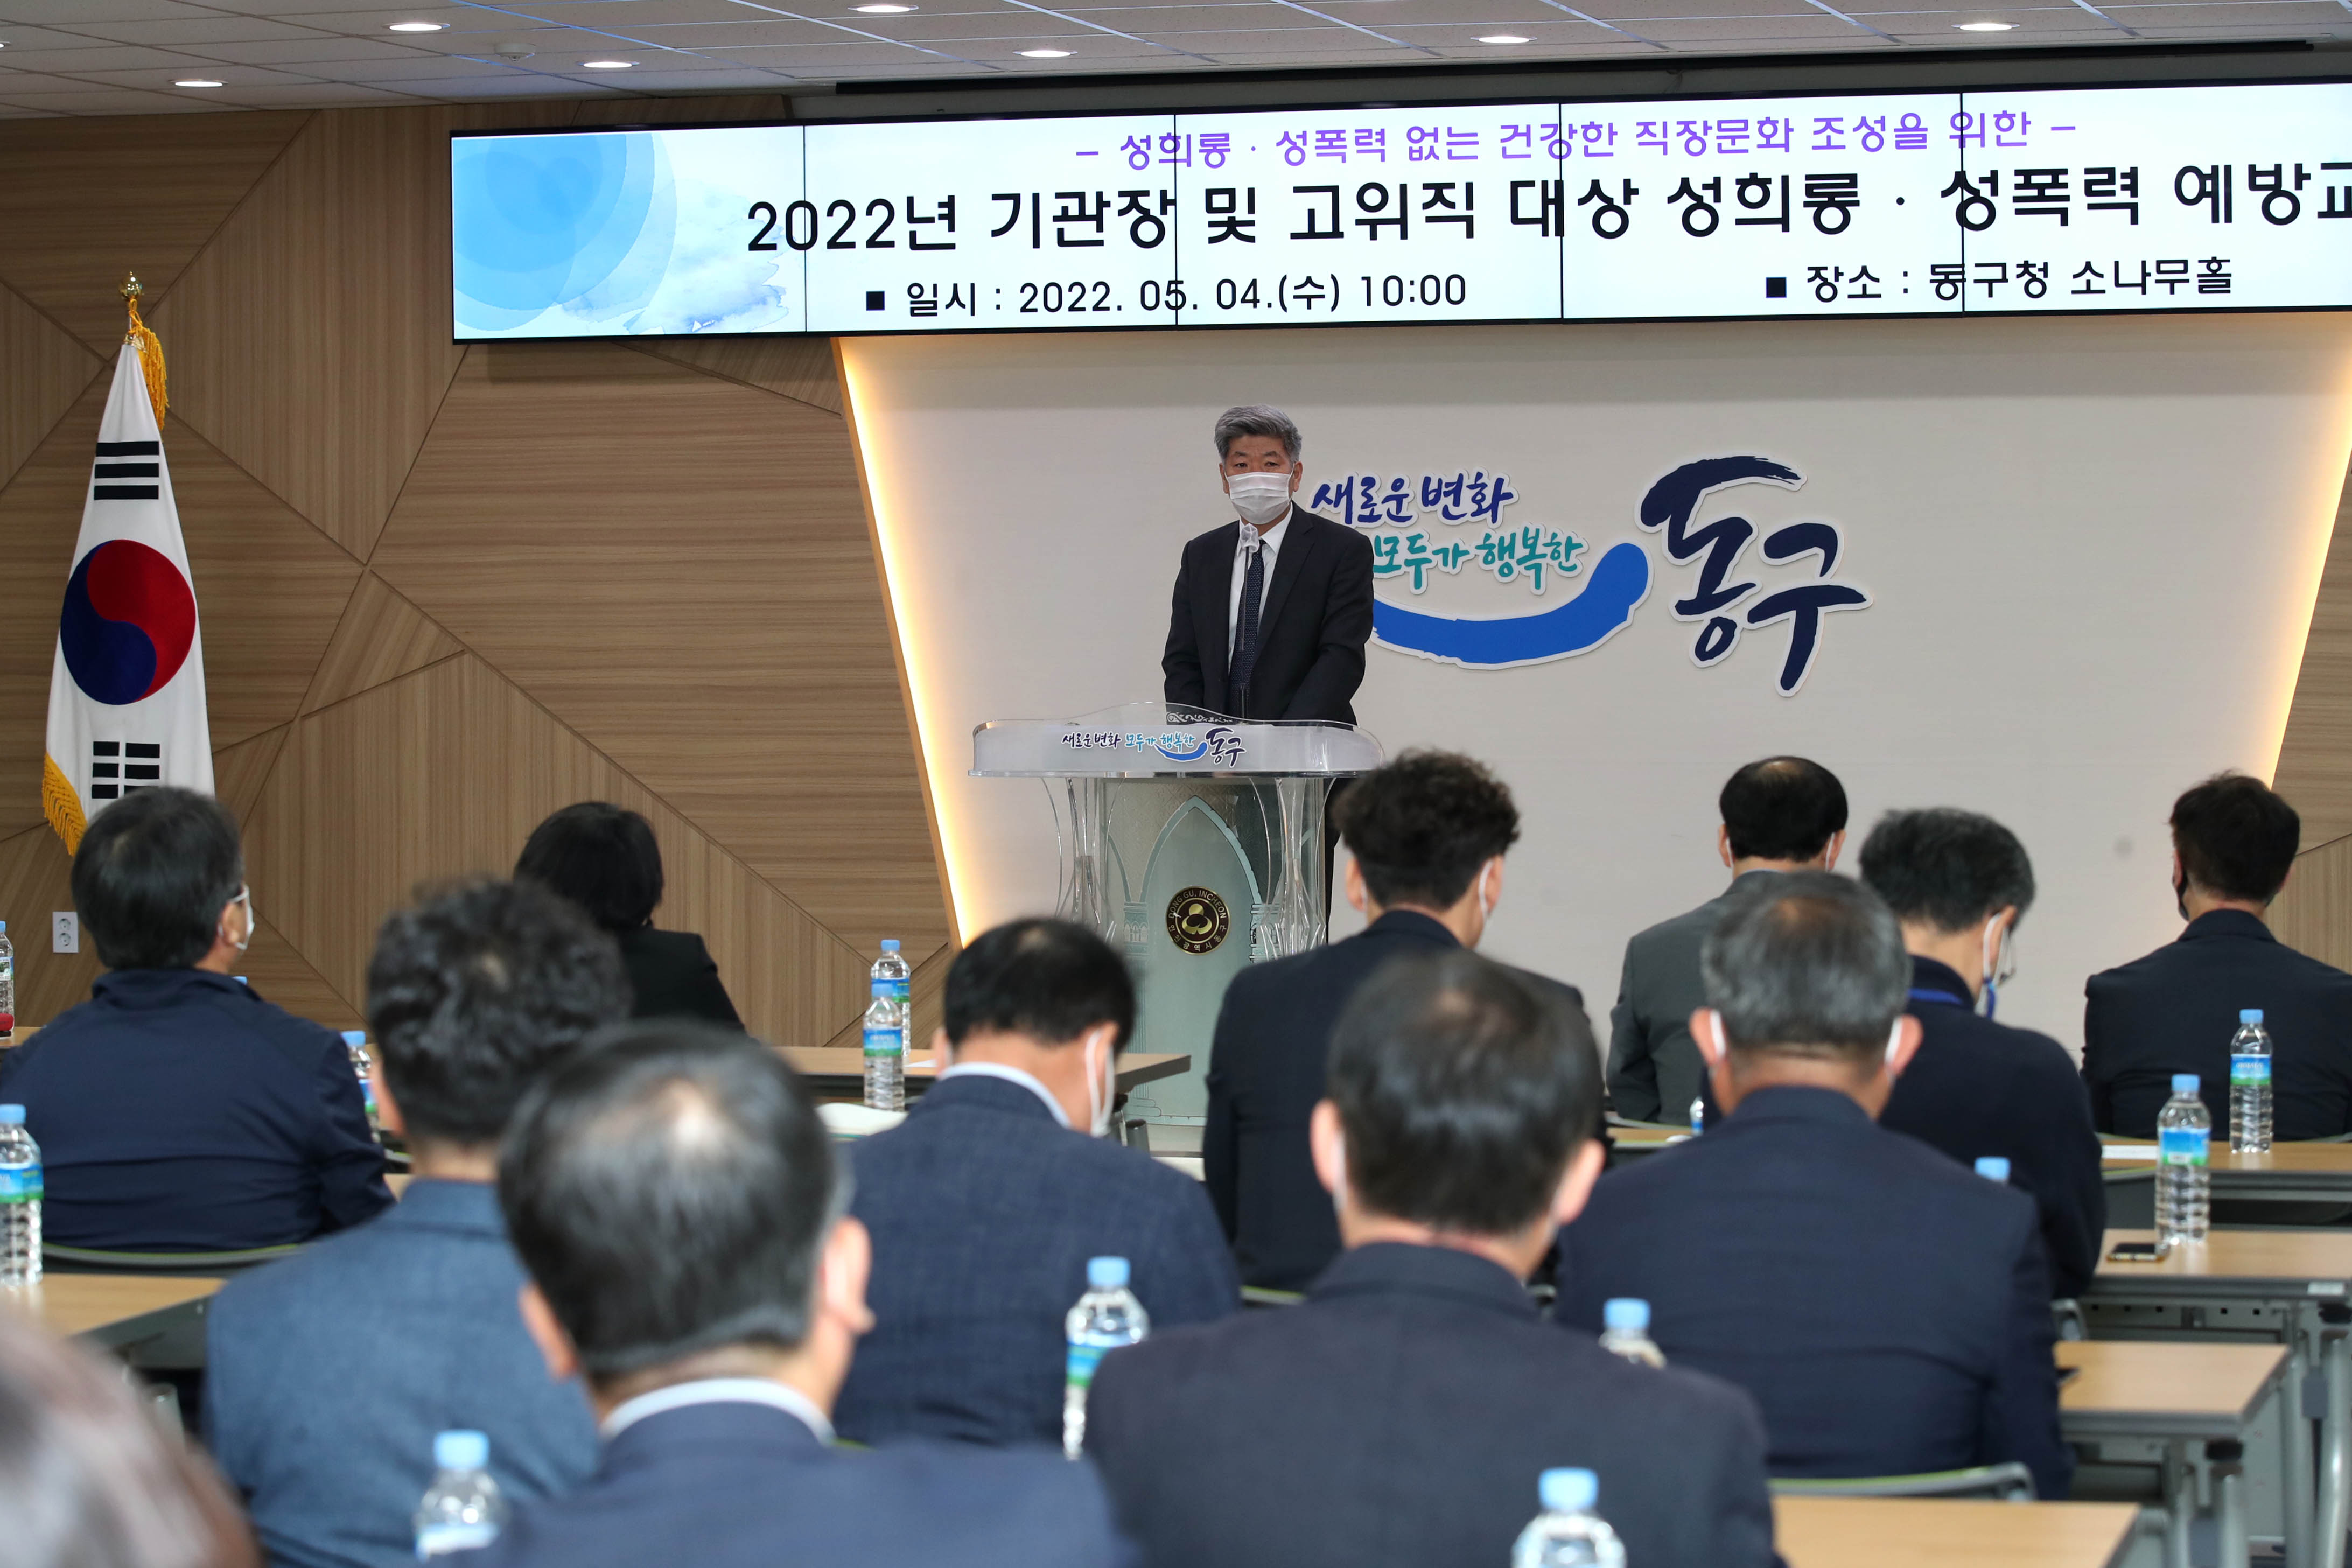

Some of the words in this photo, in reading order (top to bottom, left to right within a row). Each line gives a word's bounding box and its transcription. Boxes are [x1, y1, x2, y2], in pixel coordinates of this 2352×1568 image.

[1121, 133, 1231, 171] 성희롱
[1276, 129, 1385, 167] 성폭력
[1406, 126, 1480, 162] 없는
[1500, 120, 1618, 160] 건강한
[1636, 116, 1794, 157] 직장문화
[1811, 113, 1928, 153] 조성을
[1949, 110, 2032, 150] 위한
[748, 193, 956, 251] 2022년
[991, 189, 1176, 249] 기관장
[1205, 187, 1256, 244] 및
[1290, 181, 1474, 241] 고위직
[1510, 178, 1639, 239] 대상
[1667, 172, 1860, 237] 성희롱
[1941, 166, 2139, 232] 성폭력
[907, 283, 975, 317] 일시
[1020, 281, 1122, 313] 2022.
[1140, 279, 1198, 311] 05.
[1361, 274, 1466, 306] 10:00
[1807, 265, 1882, 303] 장소
[1930, 260, 2048, 300] 동구청
[2071, 256, 2232, 295] 소나무홀
[1311, 476, 1413, 524] 새로운
[1421, 472, 1514, 524] 변화
[1373, 533, 1470, 590] 모두가
[1475, 527, 1584, 590] 행복한
[1640, 455, 1867, 691] 동구
[1062, 733, 1092, 748] 새로운
[1094, 732, 1121, 748] 변화
[1125, 733, 1157, 751] 모두가
[1160, 732, 1196, 752] 행복한
[1205, 727, 1245, 767] 동구
[1168, 895, 1184, 919] DONG
[1199, 890, 1227, 919] INCHEON
